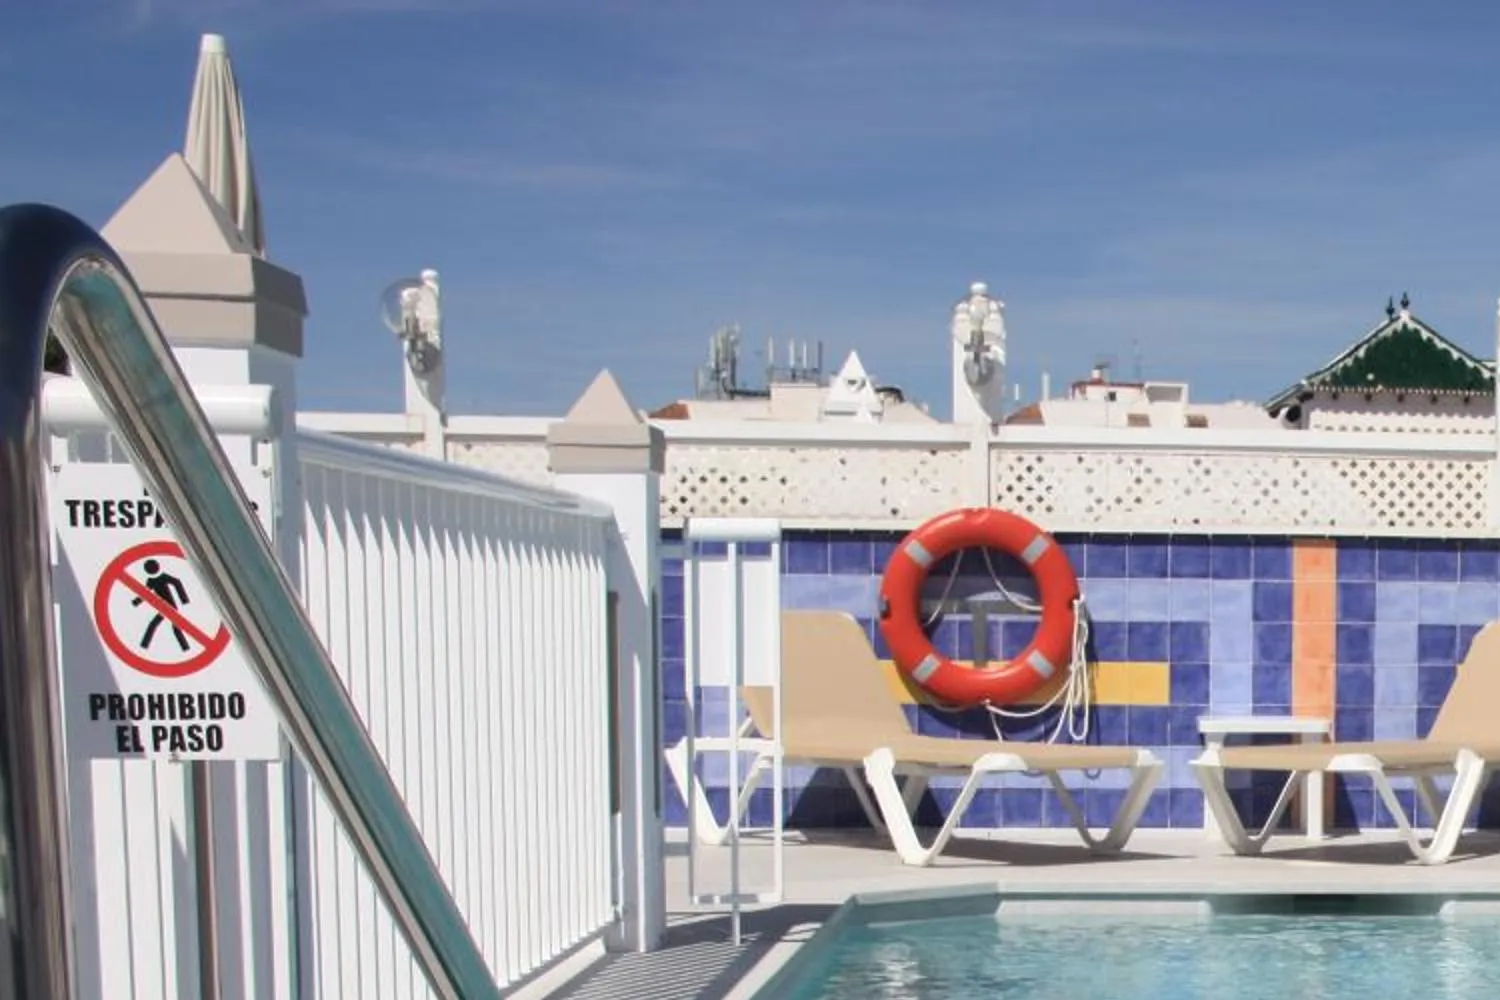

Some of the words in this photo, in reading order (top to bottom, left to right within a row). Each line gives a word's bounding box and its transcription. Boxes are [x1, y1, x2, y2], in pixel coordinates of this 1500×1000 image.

[89, 692, 245, 720] PROHIBIDO
[116, 724, 145, 752] EL
[152, 724, 223, 752] PASO
